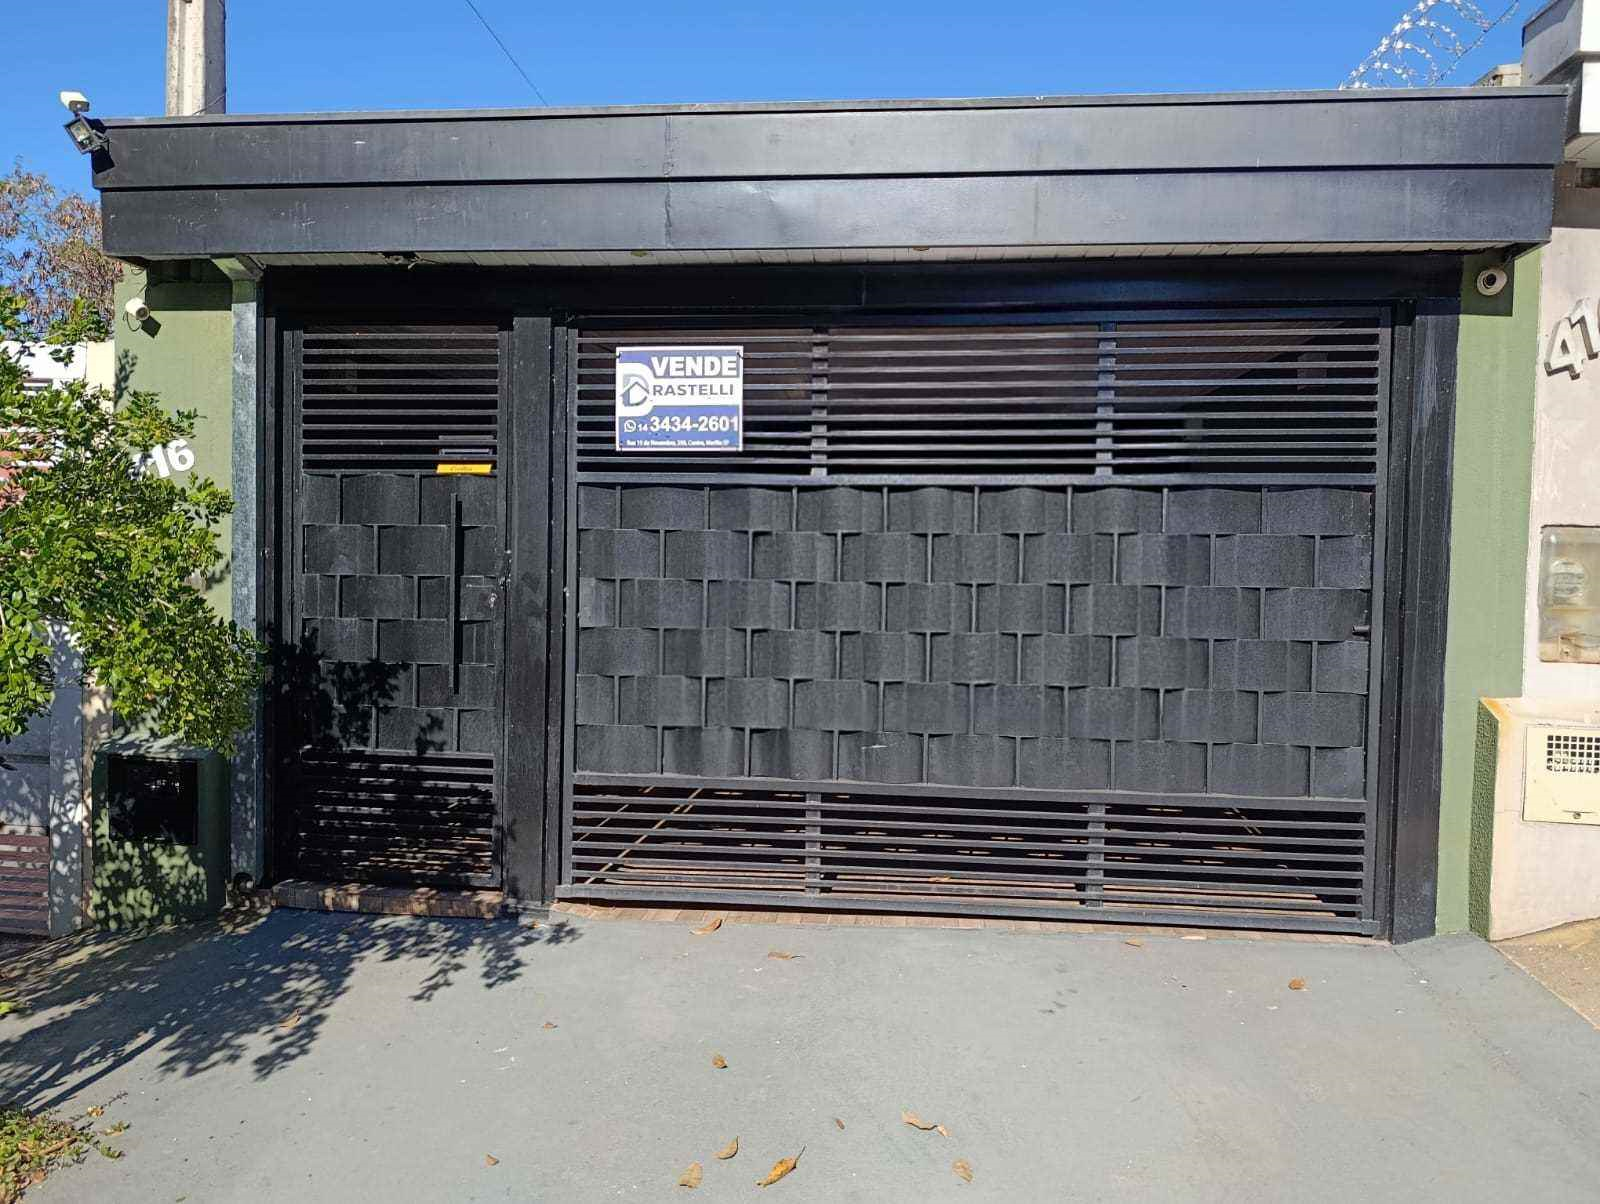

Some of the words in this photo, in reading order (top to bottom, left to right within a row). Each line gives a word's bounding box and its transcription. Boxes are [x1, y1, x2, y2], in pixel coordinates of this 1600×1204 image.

[651, 356, 737, 377] VENDE
[652, 383, 734, 397] RASTELLI
[650, 416, 738, 432] 3434-2601
